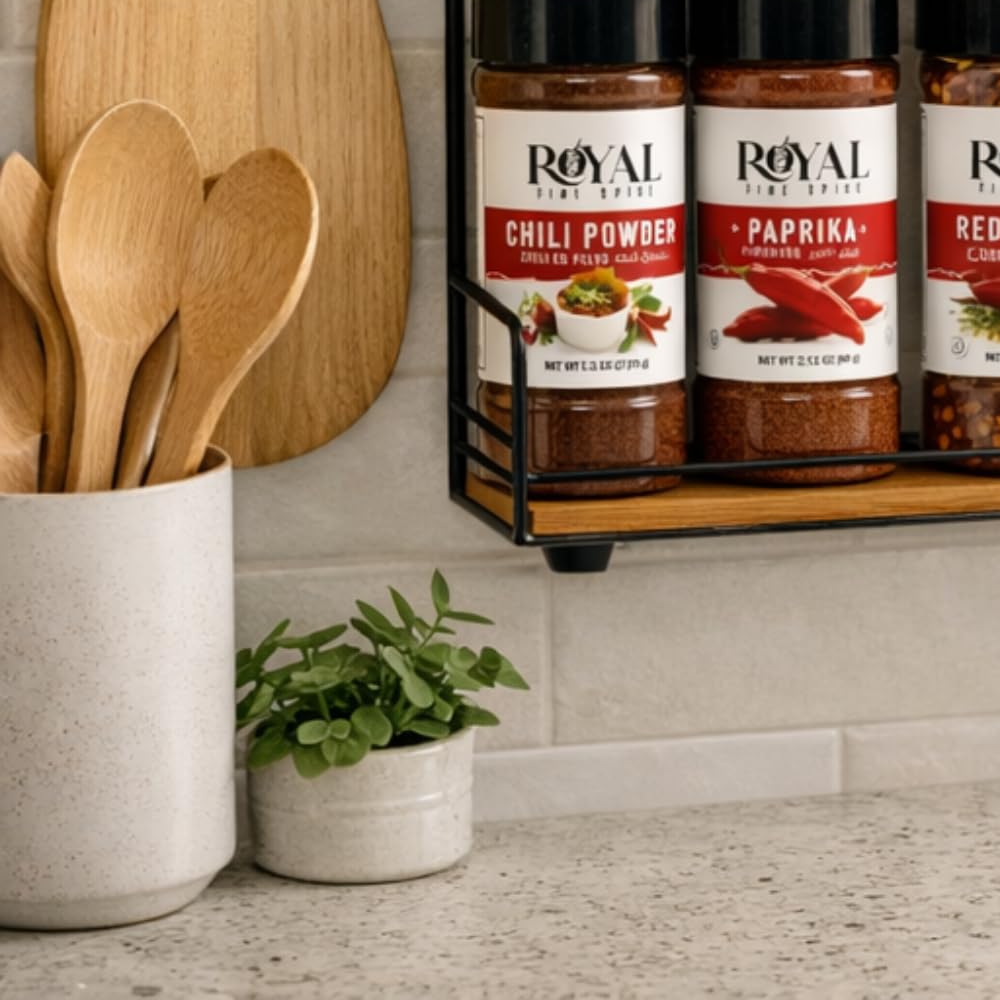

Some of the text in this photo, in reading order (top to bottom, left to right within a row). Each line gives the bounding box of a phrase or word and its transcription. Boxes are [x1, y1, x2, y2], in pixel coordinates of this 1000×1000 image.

[527, 138, 662, 186] ROYAL
[737, 136, 870, 182] ROYAL
[506, 218, 676, 250] CHILI POWDER
[749, 217, 857, 244] PAPRIKA
